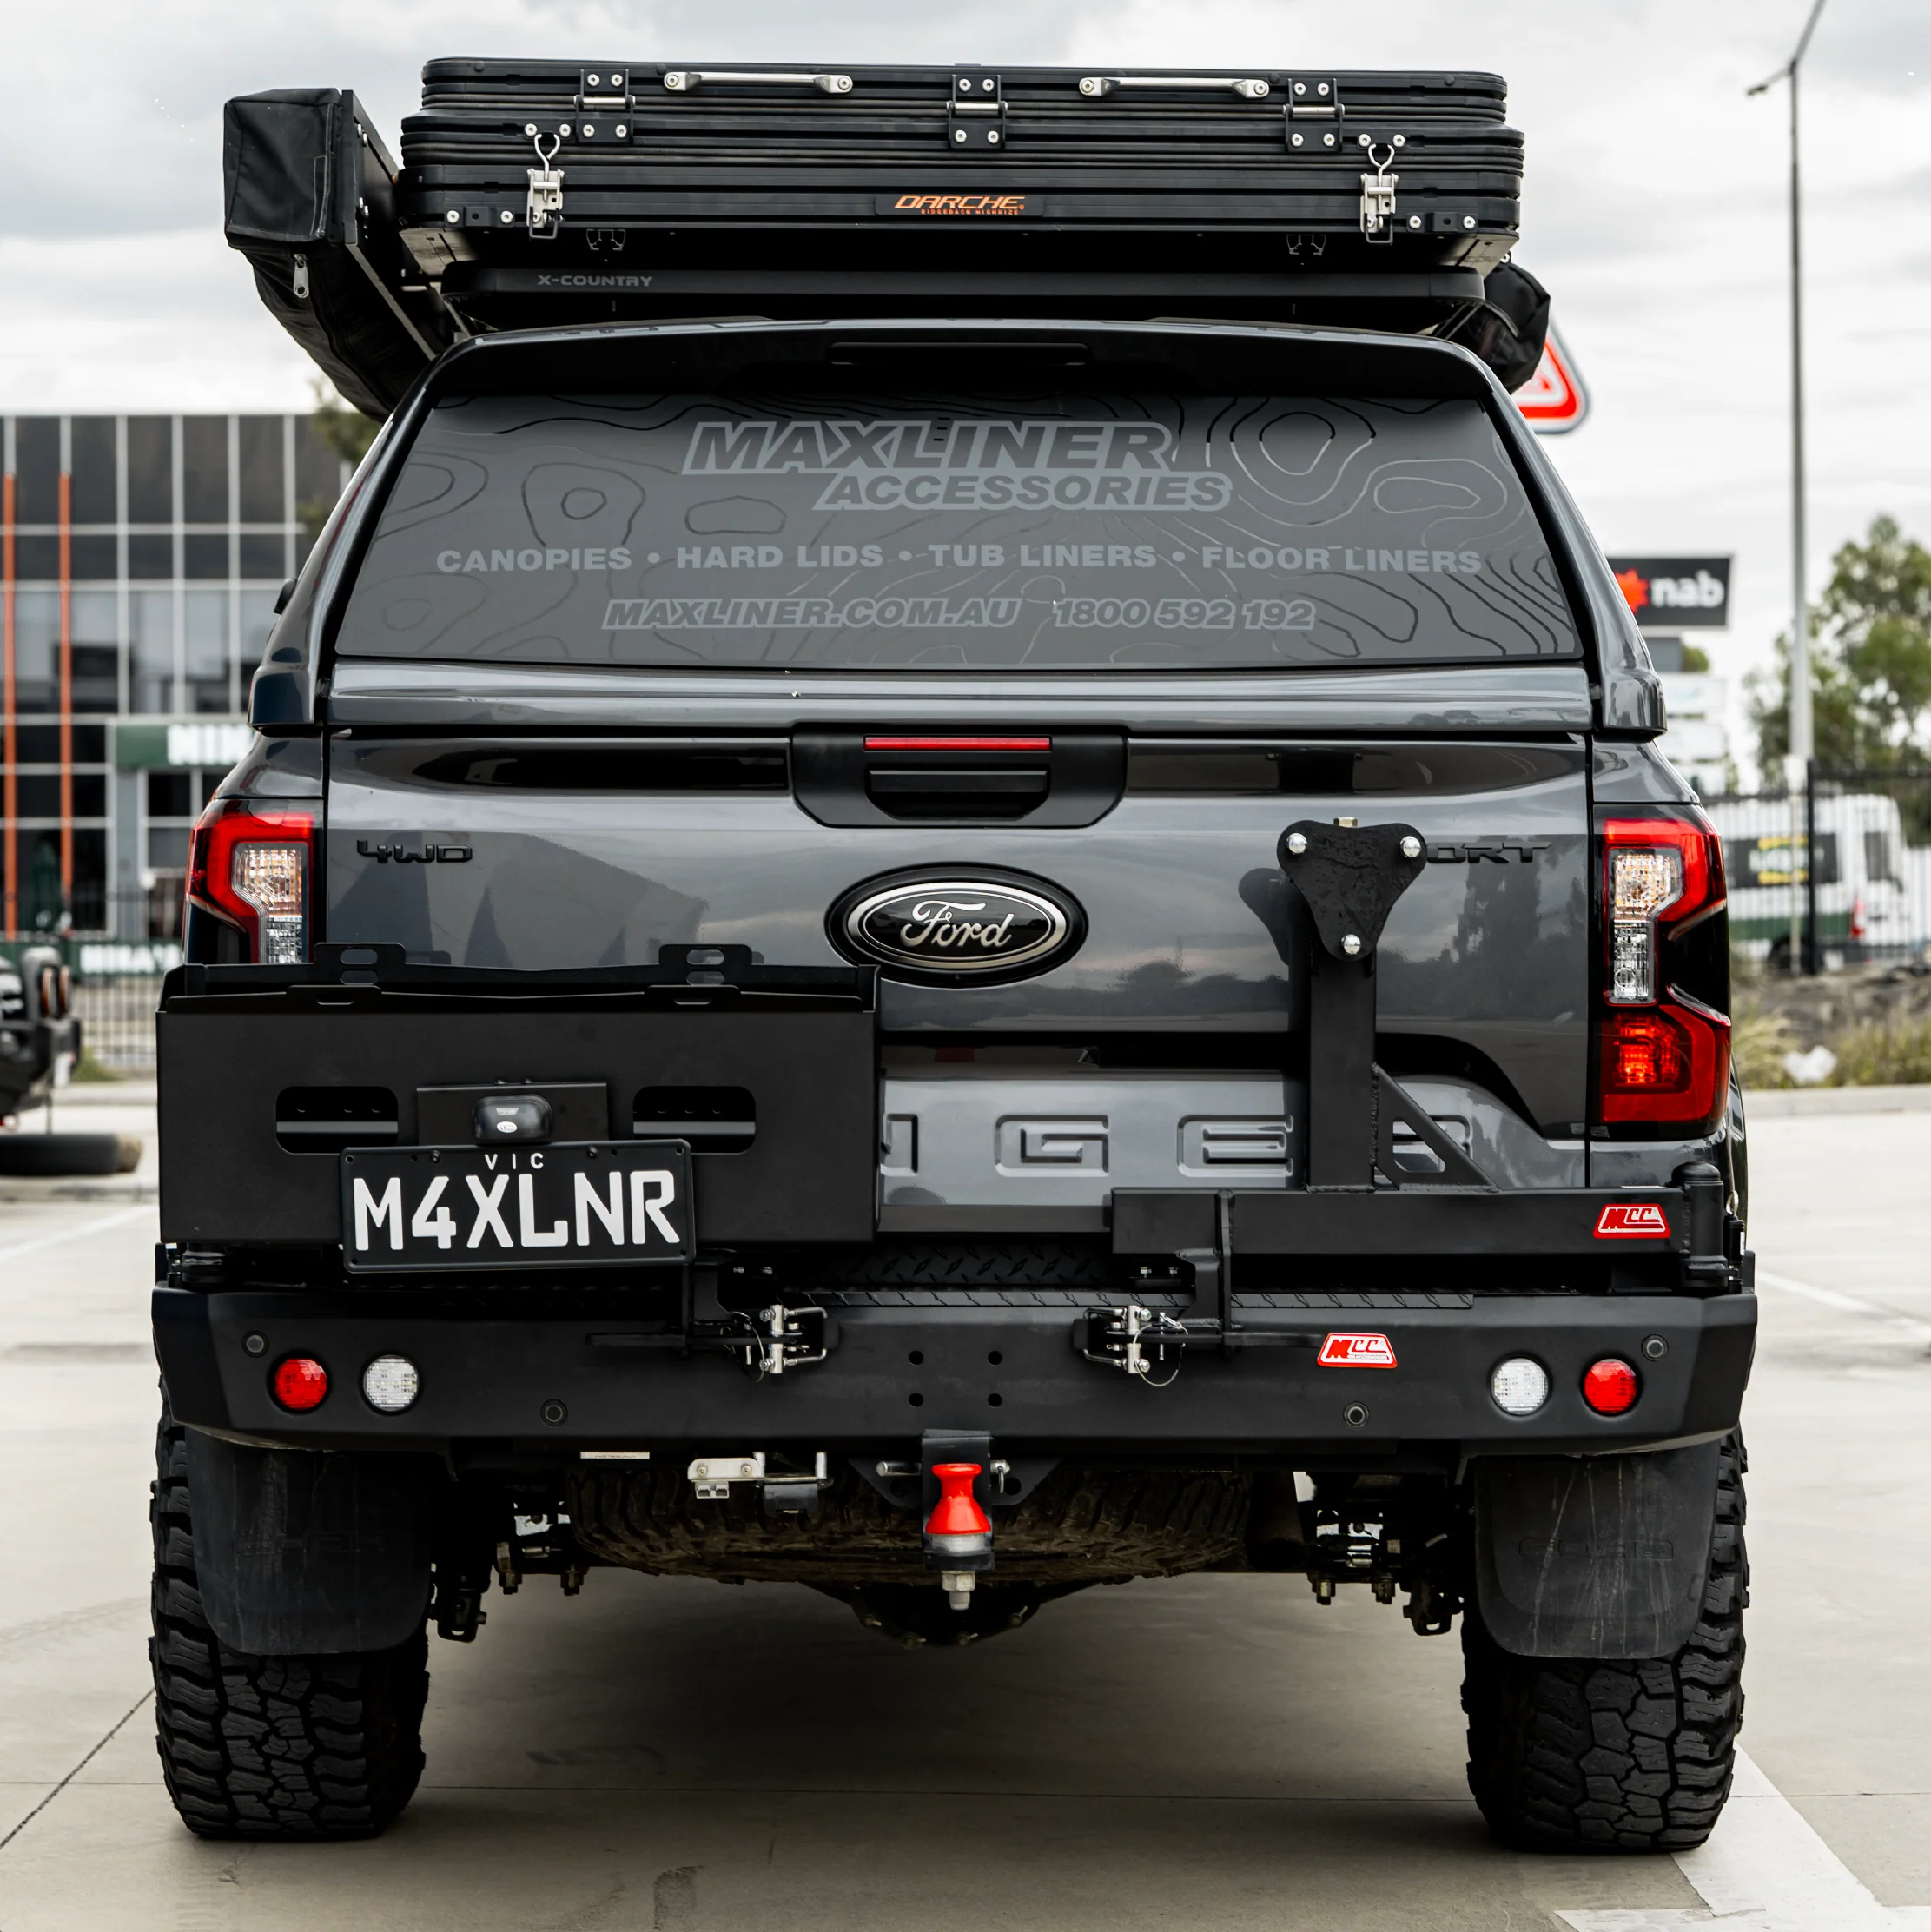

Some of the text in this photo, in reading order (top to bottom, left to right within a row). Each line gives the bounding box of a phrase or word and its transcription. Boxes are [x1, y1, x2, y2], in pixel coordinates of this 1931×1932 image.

[537, 275, 652, 287] X-COUNTRY
[682, 420, 1178, 476] MAXLINER
[812, 469, 1233, 511] ACCESSORIES
[436, 544, 1482, 574] CANOPIES HARD LIDS TUB LINERS FLOOR LINERS
[1649, 569, 1725, 607] nab
[601, 597, 1317, 630] MAXLINER.COM.AU 1800 592 192
[356, 839, 473, 863] 4WD
[900, 900, 1015, 947] Ford
[484, 1152, 545, 1171] VIC
[353, 1170, 681, 1252] M4XLNR
